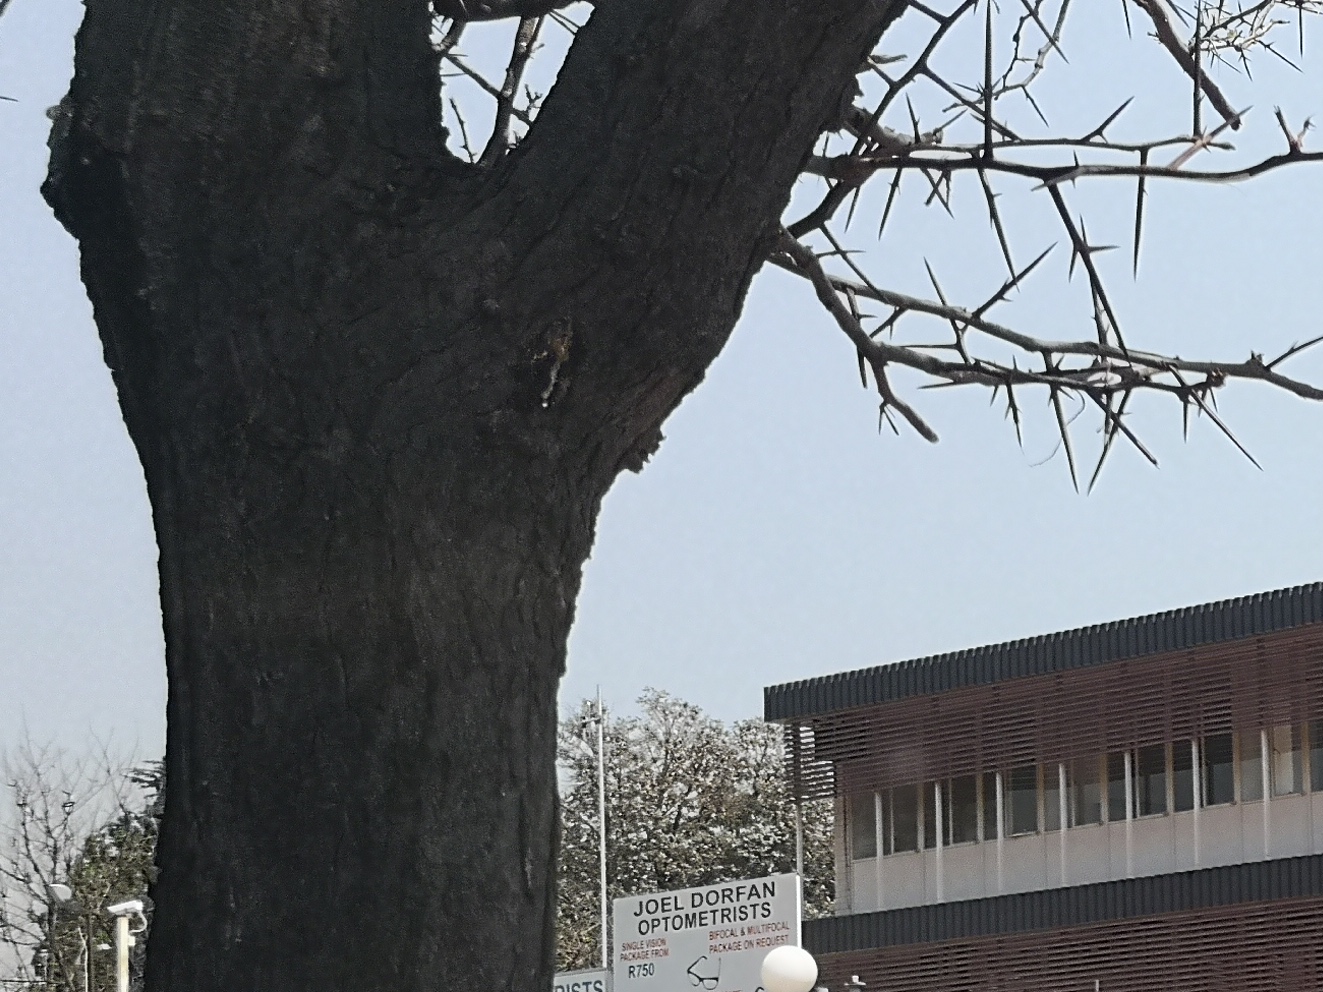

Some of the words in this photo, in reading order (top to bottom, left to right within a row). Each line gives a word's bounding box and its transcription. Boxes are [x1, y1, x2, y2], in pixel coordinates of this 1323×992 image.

[634, 896, 684, 916] JOEL
[692, 881, 775, 908] DORFAN
[638, 902, 771, 935] OPTOMETRISTS
[709, 929, 738, 940] BIFOCAL
[740, 927, 746, 936] &
[747, 921, 790, 935] MULTIFOCAL
[622, 940, 644, 951] SINGLE
[646, 938, 666, 948] VISION
[709, 941, 742, 954] PACKAGE
[744, 940, 754, 950] ON
[756, 934, 789, 948] REQUEST
[620, 950, 650, 961] PACKAGE
[651, 948, 670, 958] FROM
[628, 962, 654, 978] R750
